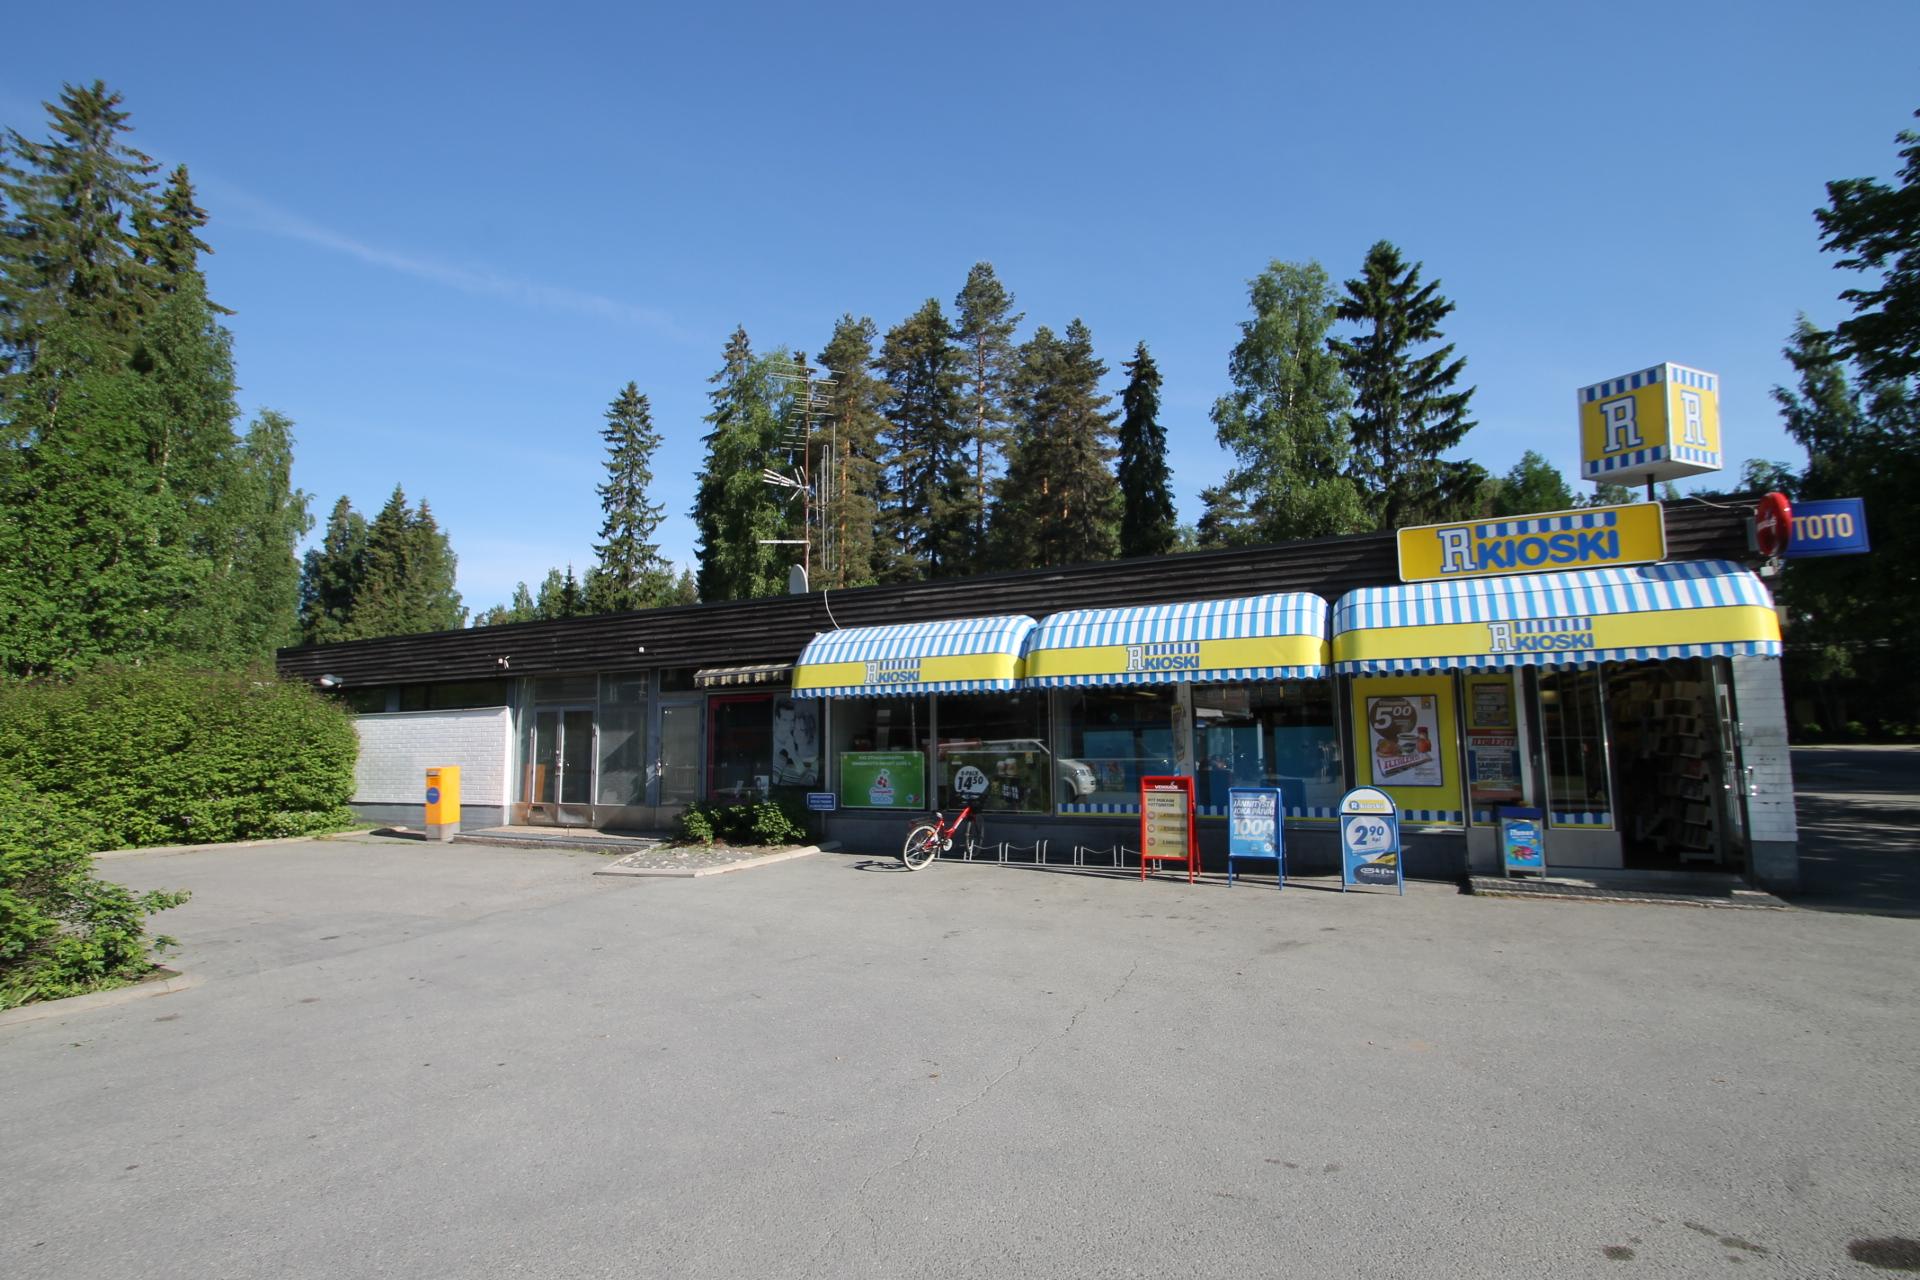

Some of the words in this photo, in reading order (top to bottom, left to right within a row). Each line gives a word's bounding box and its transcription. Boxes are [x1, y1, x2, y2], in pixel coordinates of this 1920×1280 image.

[1600, 395, 1644, 454] R
[1680, 390, 1706, 447] R
[1478, 529, 1620, 570] KIOSKI
[1516, 632, 1595, 651] KIOSKI
[878, 670, 921, 683] KIOSKI
[1144, 656, 1200, 671] KIOSKI
